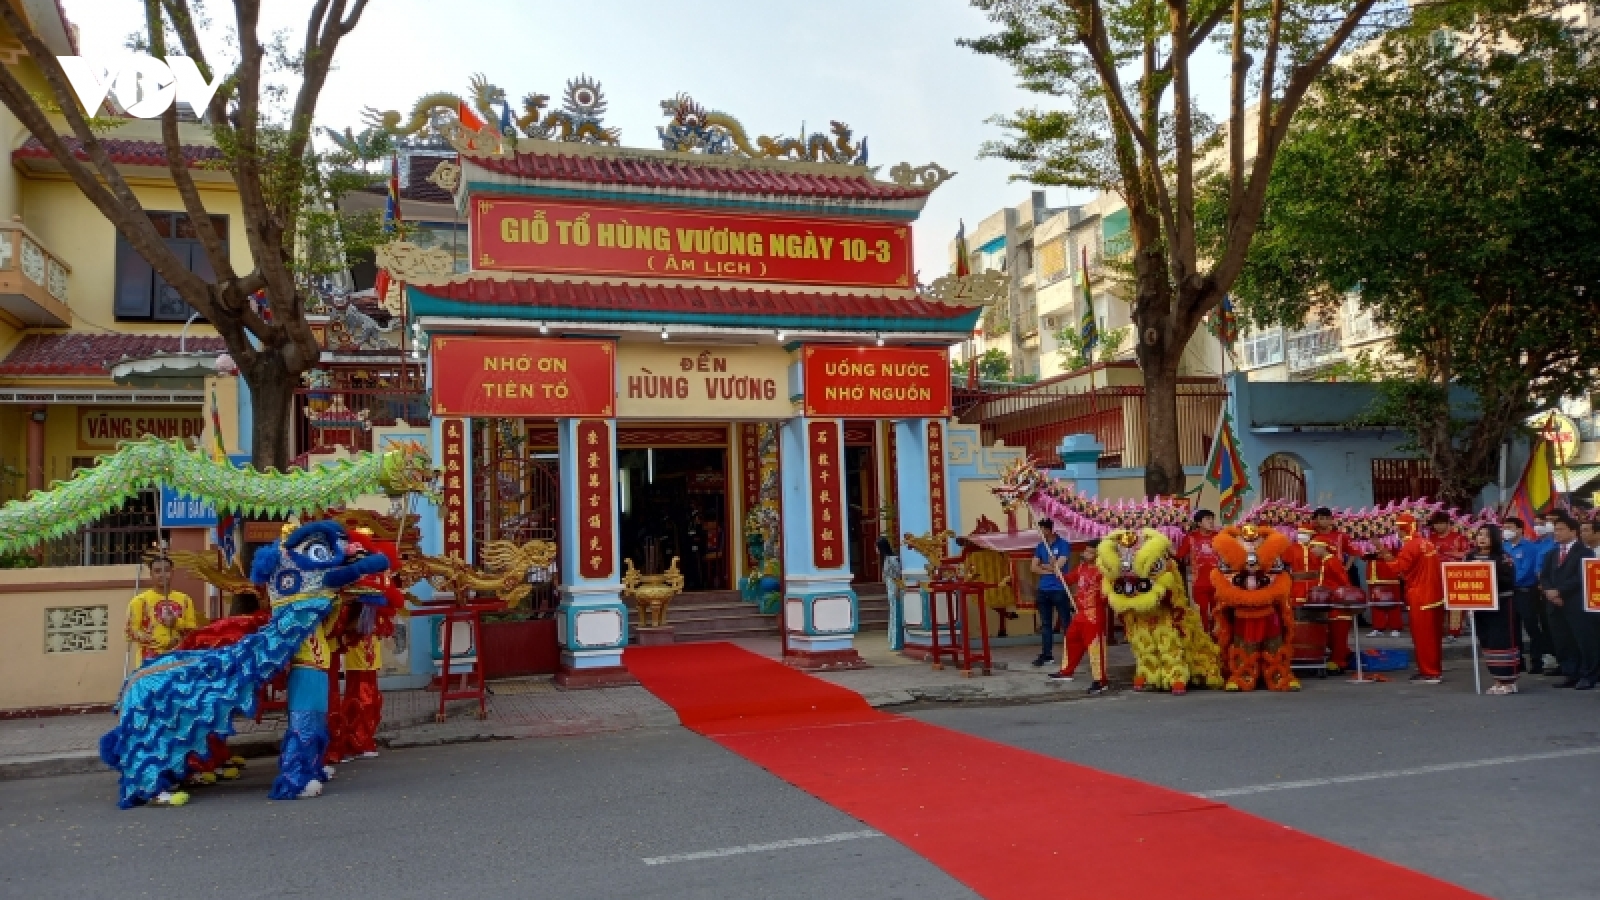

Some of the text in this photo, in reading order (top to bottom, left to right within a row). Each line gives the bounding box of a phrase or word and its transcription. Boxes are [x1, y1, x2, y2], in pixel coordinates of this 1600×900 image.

[501, 210, 891, 263] GIỖ TỔ HÙNG VƯƠNG NGÀY 10-3
[664, 254, 695, 270] ÂM
[704, 261, 751, 277] LỊCH
[483, 354, 567, 373] NHỚ ƠN
[825, 358, 931, 378] UỐNG NƯỚC
[482, 379, 535, 399] TIÊN
[628, 366, 777, 401] HÙNG VƯƠNG
[825, 382, 931, 401] NHỚ NGUỒN
[87, 413, 133, 439] VÃNG
[136, 417, 179, 439] SANH
